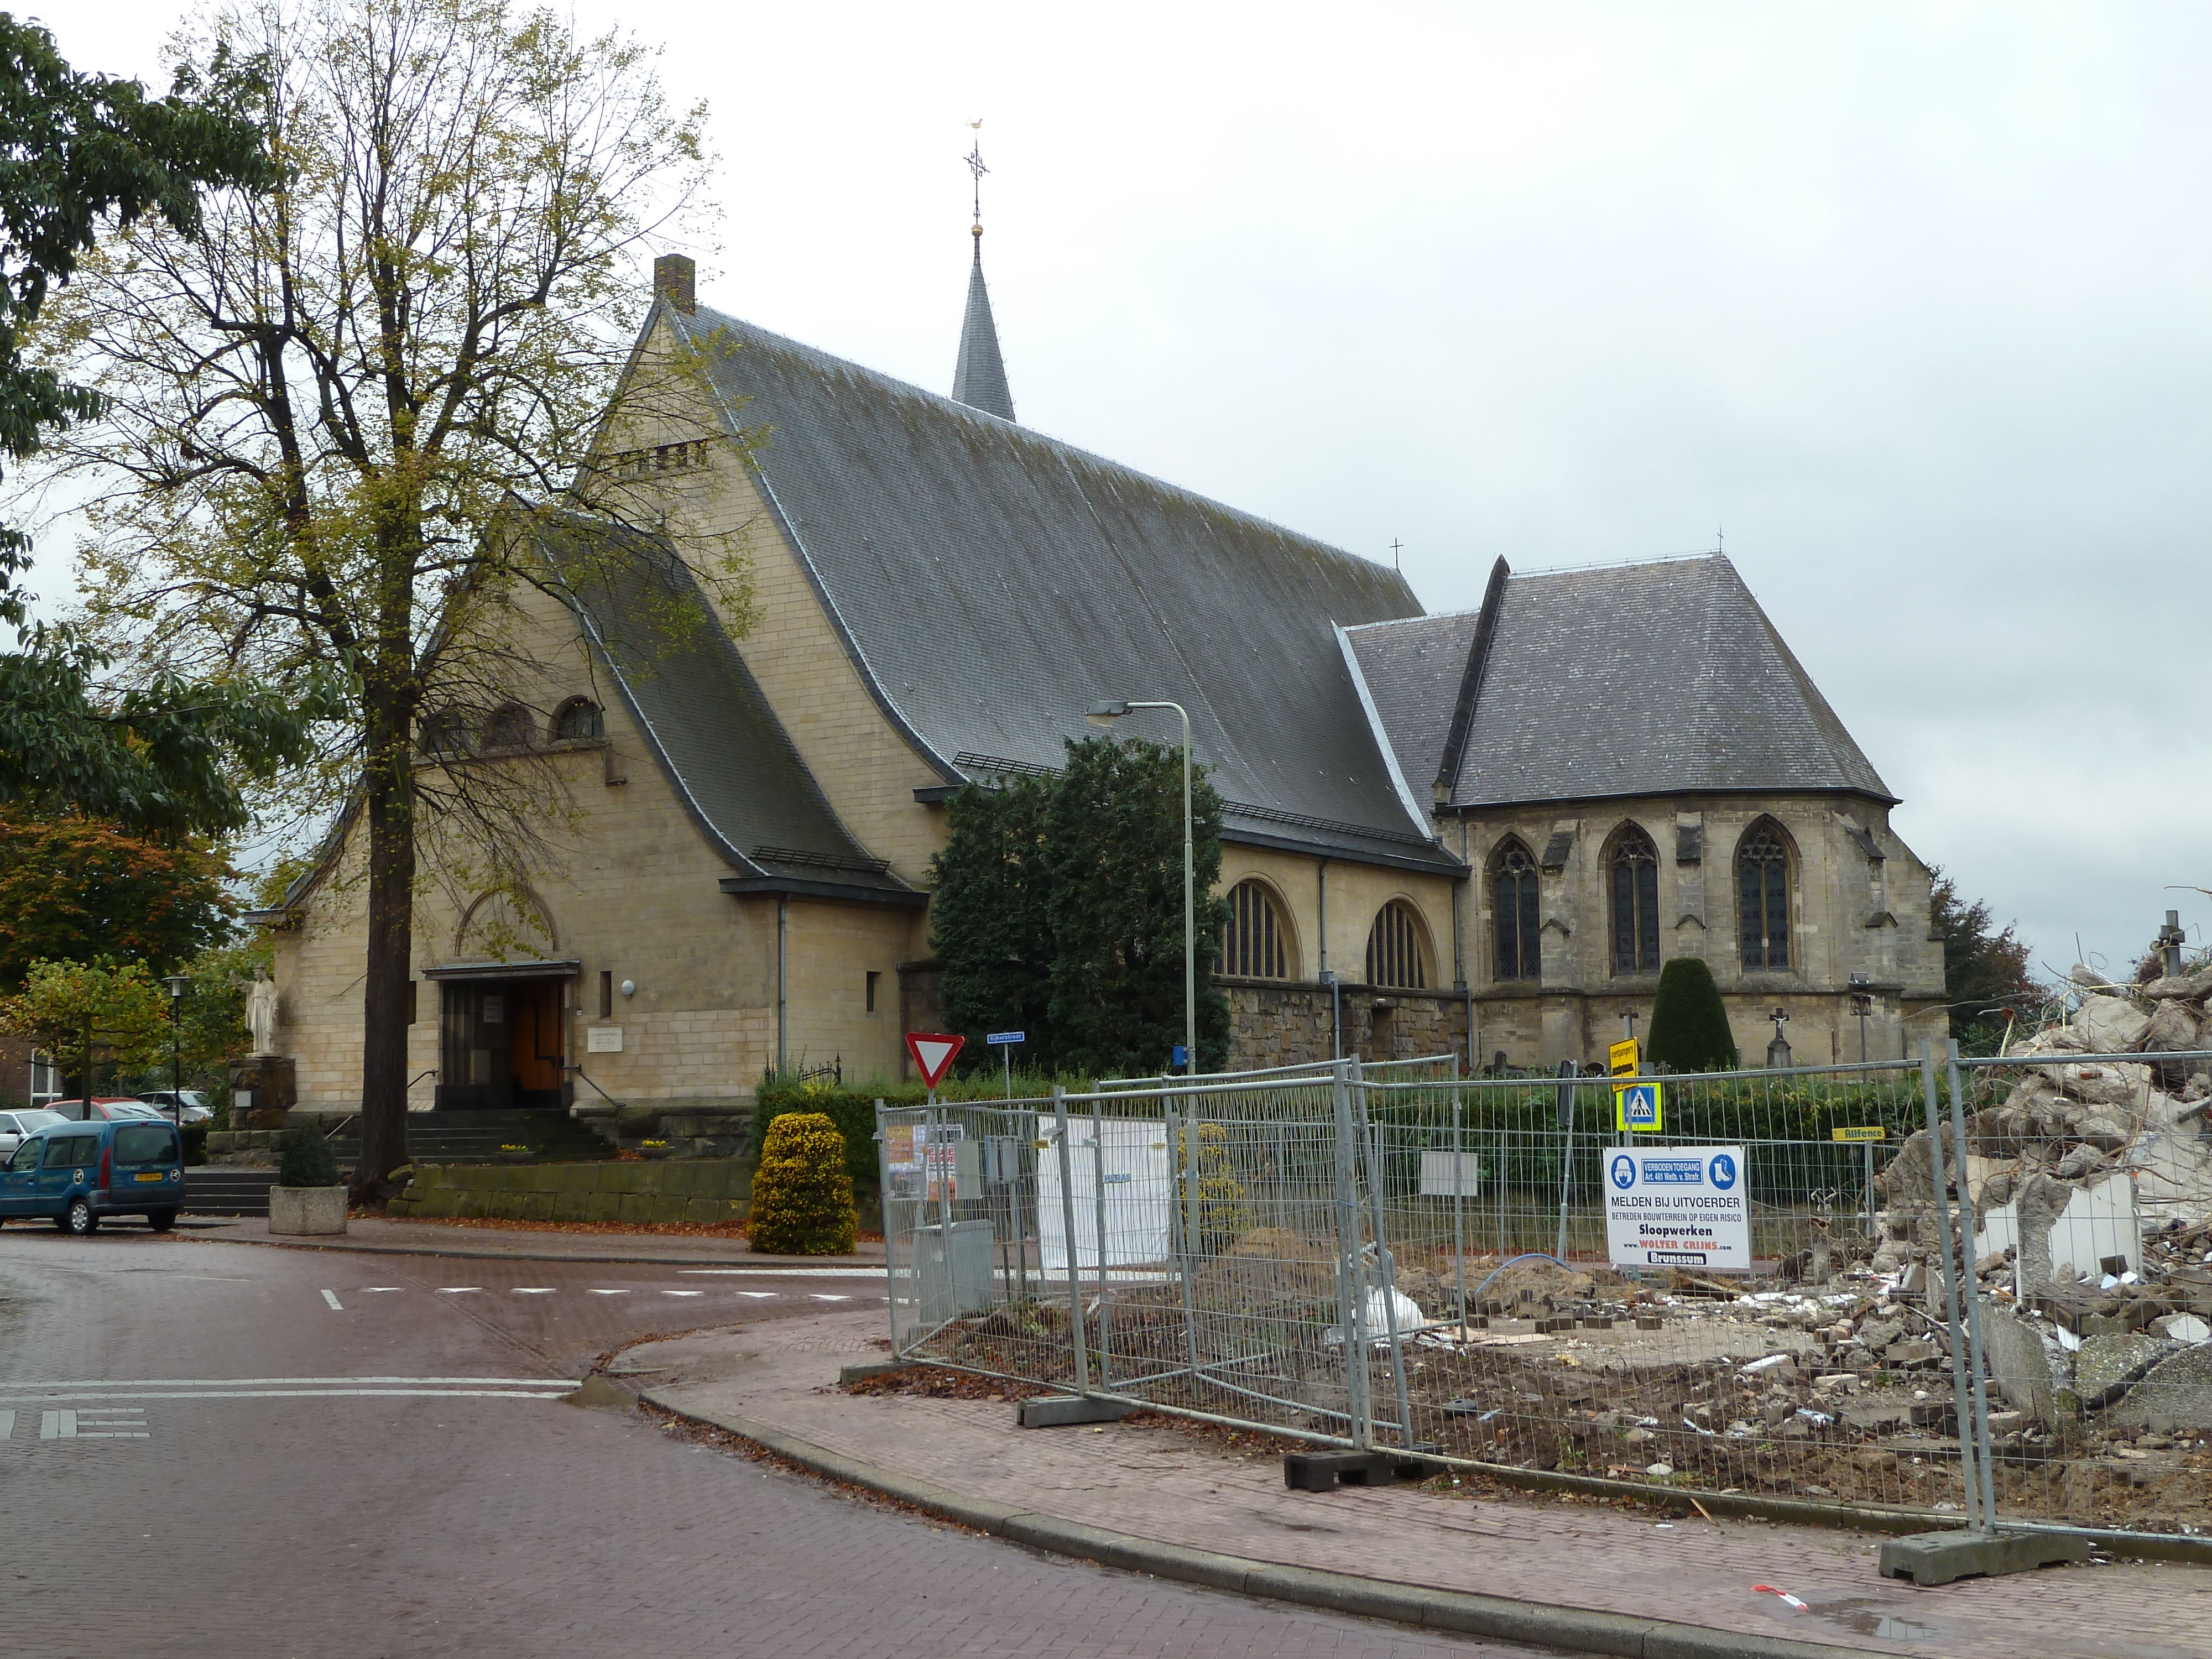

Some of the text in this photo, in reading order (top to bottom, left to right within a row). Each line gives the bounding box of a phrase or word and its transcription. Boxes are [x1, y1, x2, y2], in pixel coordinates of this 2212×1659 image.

[1611, 1046, 1634, 1059] voetgangers
[1845, 1129, 1882, 1138] Allfence
[1644, 1162, 1699, 1171] VERBODEN TOEGANG
[1611, 1197, 1740, 1208] MELDEN BIJ UITVOERDER
[1612, 1212, 1641, 1220] BETREDEN
[1644, 1213, 1687, 1221] BOUWTERREIN
[1720, 1214, 1741, 1222] RISICO
[1639, 1224, 1712, 1237] Sloopwerken
[1651, 1253, 1704, 1264] Brunssum
